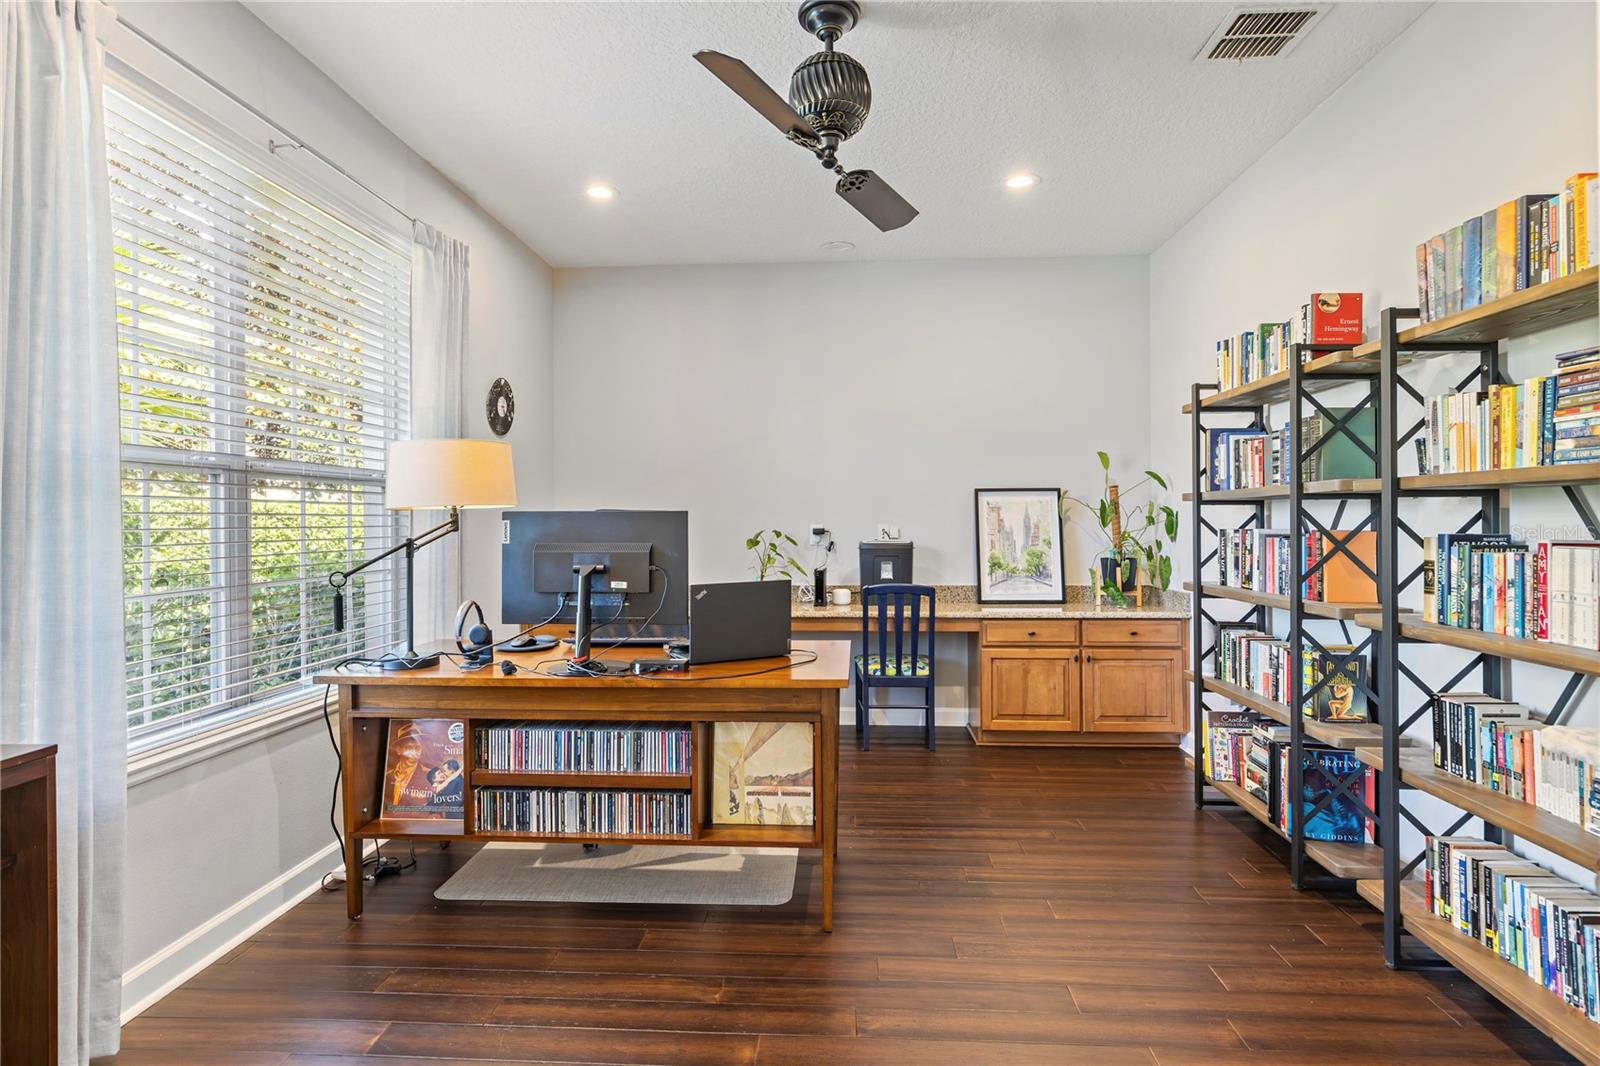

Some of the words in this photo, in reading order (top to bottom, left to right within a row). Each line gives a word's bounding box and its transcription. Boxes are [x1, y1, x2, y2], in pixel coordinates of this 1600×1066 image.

[1538, 546, 1547, 583] AMY
[1538, 592, 1548, 632] TAN
[1221, 714, 1249, 723] Crochet
[434, 791, 463, 804] lovers!
[1321, 832, 1359, 841] GIDDINS
